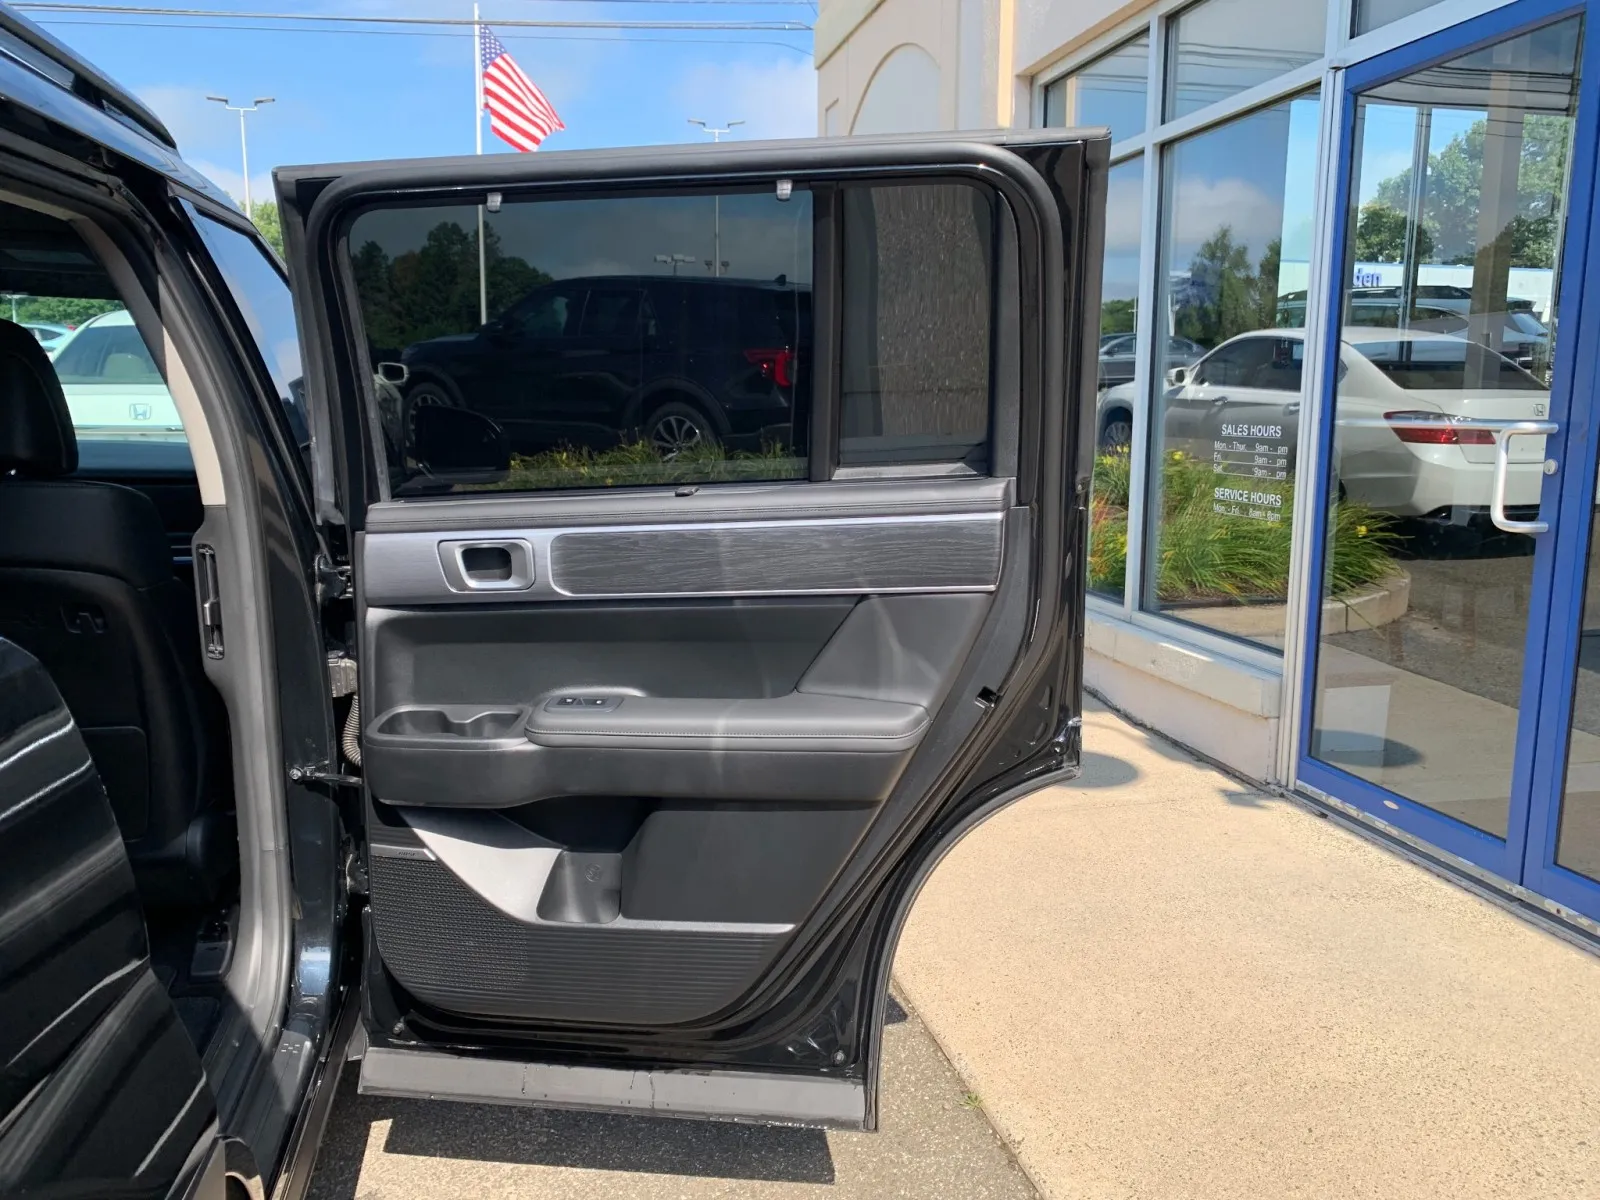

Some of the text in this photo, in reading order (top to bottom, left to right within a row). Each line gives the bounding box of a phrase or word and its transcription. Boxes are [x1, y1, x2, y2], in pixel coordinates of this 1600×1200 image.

[1221, 424, 1282, 437] SALES HOURS
[1214, 487, 1282, 505] SERVICE HOURS
